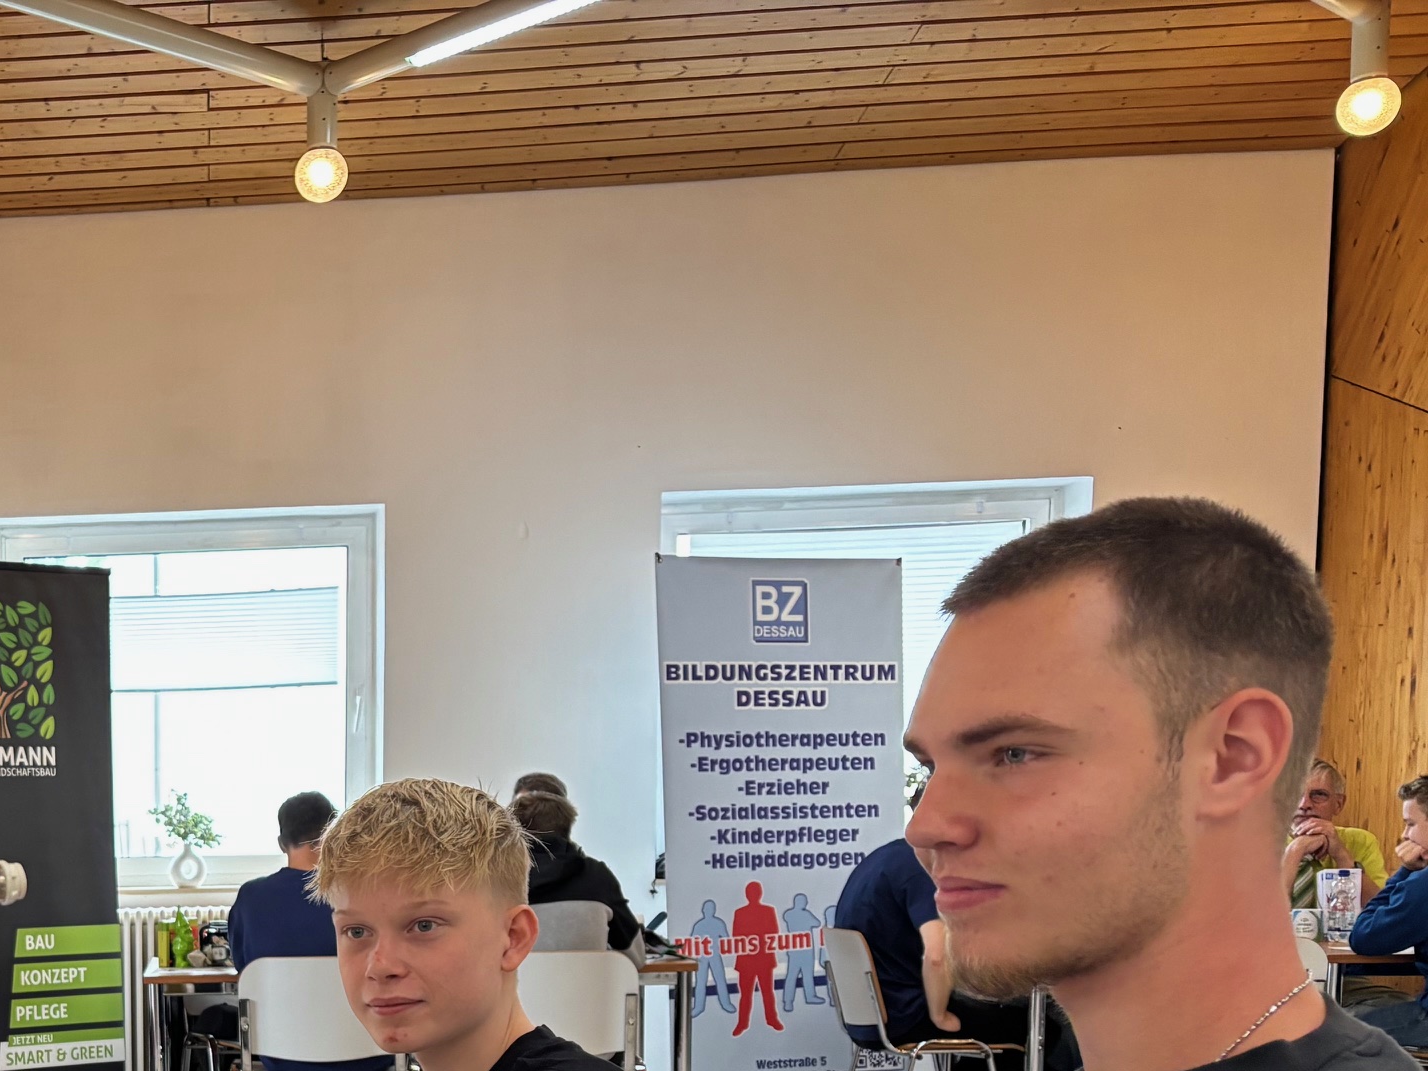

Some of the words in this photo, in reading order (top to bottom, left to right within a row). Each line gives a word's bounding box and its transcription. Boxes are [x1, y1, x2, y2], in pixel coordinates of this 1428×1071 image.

[755, 585, 804, 622] BZ
[754, 625, 805, 638] DESSAU
[665, 663, 896, 682] BILDUNGSZENTRUM
[736, 689, 827, 707] DESSAU
[678, 731, 886, 750] -Physiotherapeuten
[690, 755, 876, 775] -Ergotherapeuten
[737, 779, 830, 796] -Erzieher
[688, 803, 880, 822] -Sozialassistenten
[710, 826, 860, 846] -Kinderpfleger
[25, 933, 55, 951] BAU
[675, 936, 713, 957] Mit
[719, 934, 760, 955] uns
[765, 931, 811, 952] zum
[20, 967, 88, 986] KONZEPT
[16, 1003, 68, 1022] PFLEGE
[12, 1035, 36, 1046] JETZT
[37, 1034, 54, 1044] NEU
[6, 1048, 54, 1066] SMART
[57, 1048, 67, 1062] &
[71, 1044, 114, 1061] GREEN
[756, 1057, 818, 1070] Weststraße
[820, 1056, 827, 1066] 5
